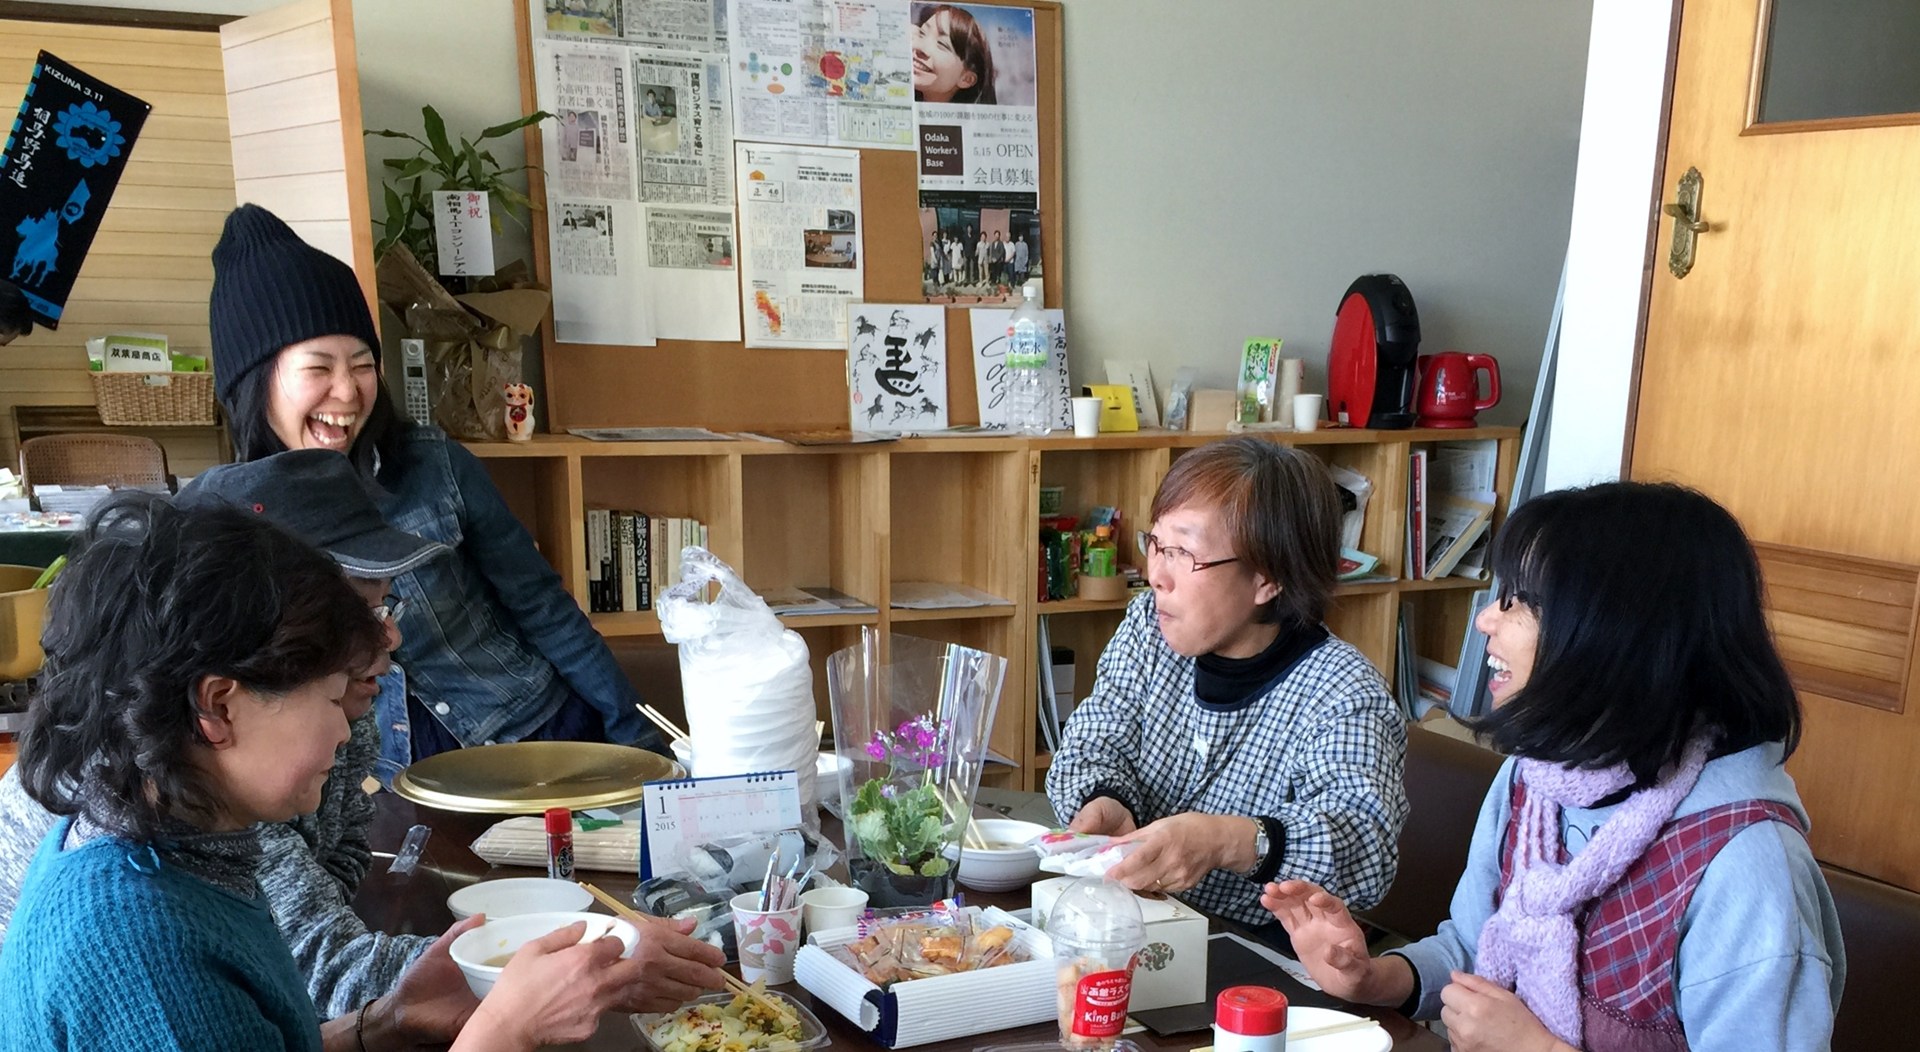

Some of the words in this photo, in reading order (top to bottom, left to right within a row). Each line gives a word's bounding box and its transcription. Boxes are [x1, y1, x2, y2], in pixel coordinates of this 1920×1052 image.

[44, 64, 82, 91] KIZUNA
[83, 87, 104, 102] 3.11
[691, 73, 703, 156] 復興ビジネス育てる場に
[925, 133, 949, 142] Odaka
[9, 107, 51, 188] 相馬野馬追
[925, 146, 957, 155] Worker's
[973, 147, 991, 157] 5.15
[996, 144, 1034, 158] OPEN
[926, 158, 945, 167] Base
[974, 167, 1035, 186] 会員募集
[466, 192, 482, 218] 御祝
[111, 348, 161, 361] 双葉屋商店
[636, 516, 648, 577] 影響力の武器
[660, 796, 667, 814] 1
[655, 821, 676, 831] 2015
[1084, 1009, 1109, 1025] King
